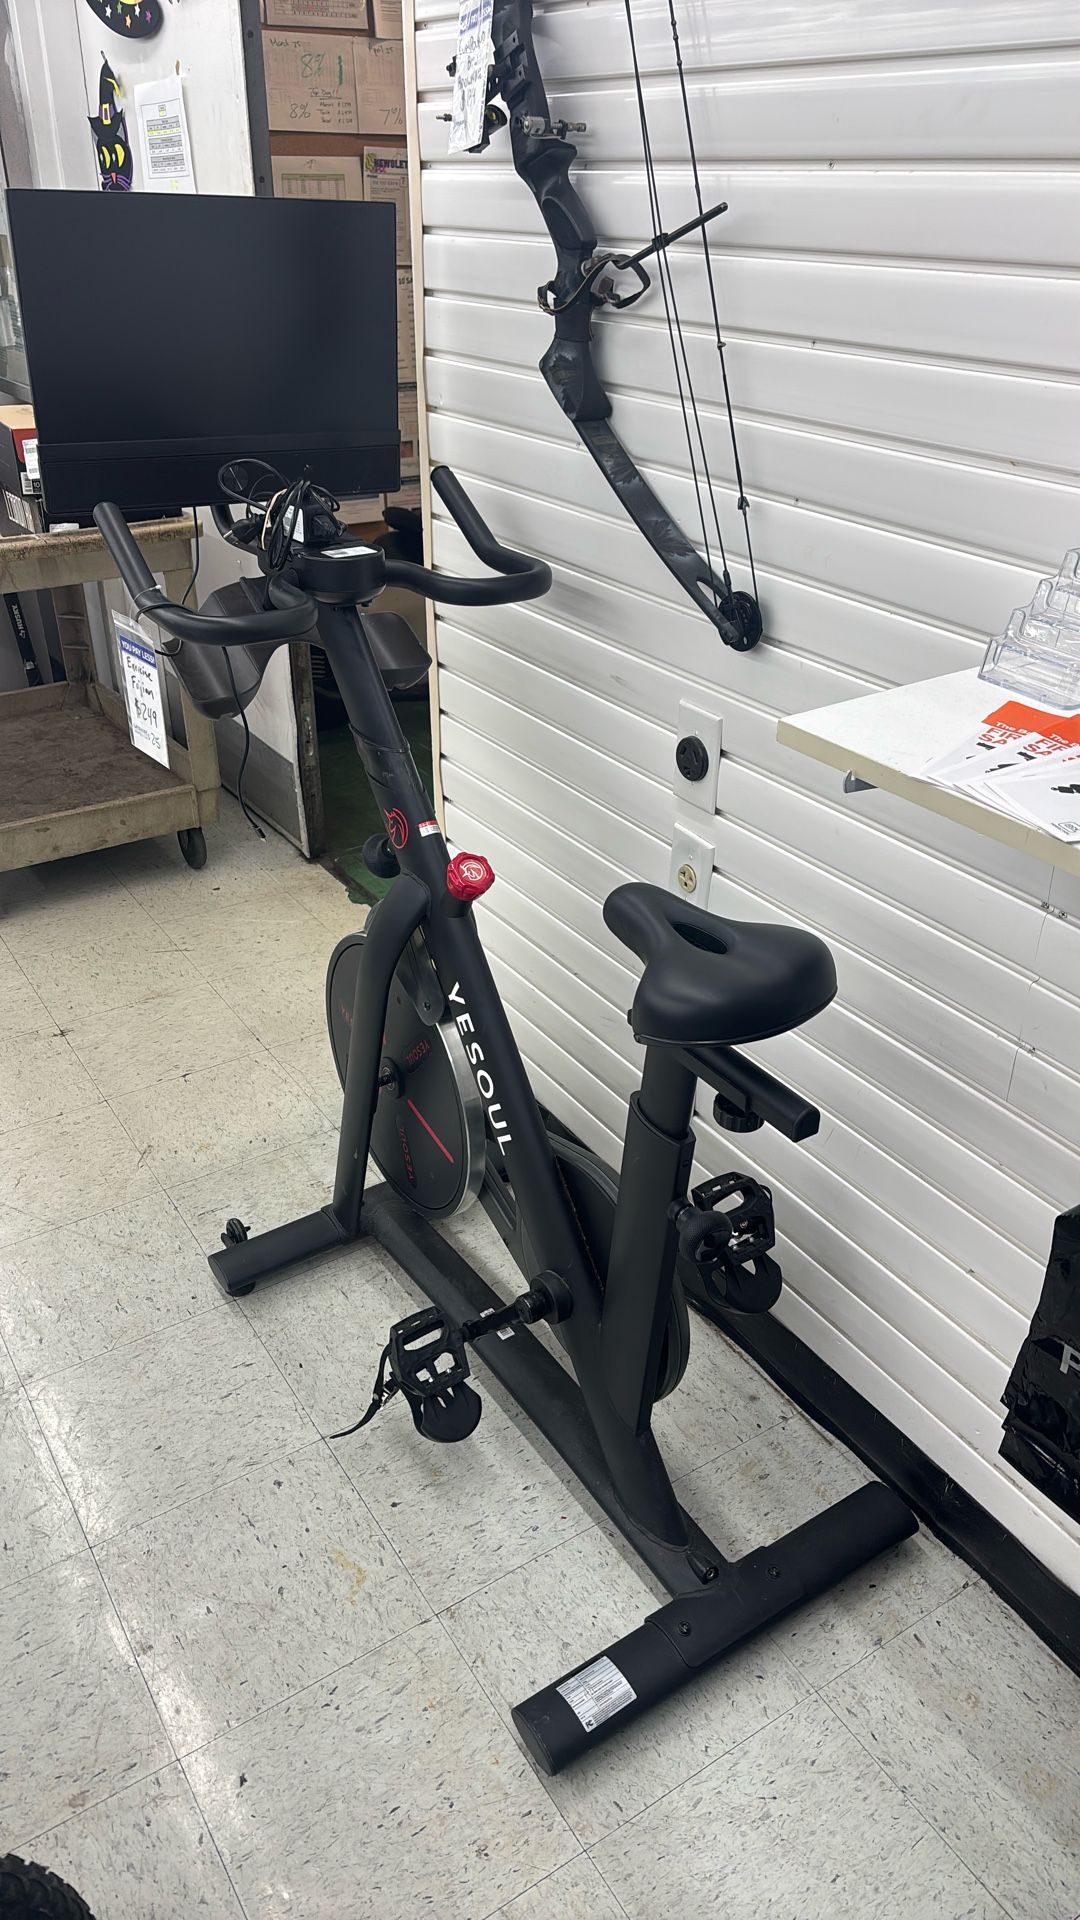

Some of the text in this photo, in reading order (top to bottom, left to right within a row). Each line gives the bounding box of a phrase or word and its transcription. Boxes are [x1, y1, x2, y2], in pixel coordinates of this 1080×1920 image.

[290, 103, 311, 119] 8%
[121, 641, 132, 653] YOU
[131, 647, 141, 658] PAY
[134, 698, 159, 728] $249
[995, 721, 1016, 731] The
[1050, 733, 1069, 744] The
[448, 981, 513, 1157] YESOUL
[398, 1125, 416, 1182] YESOUL
